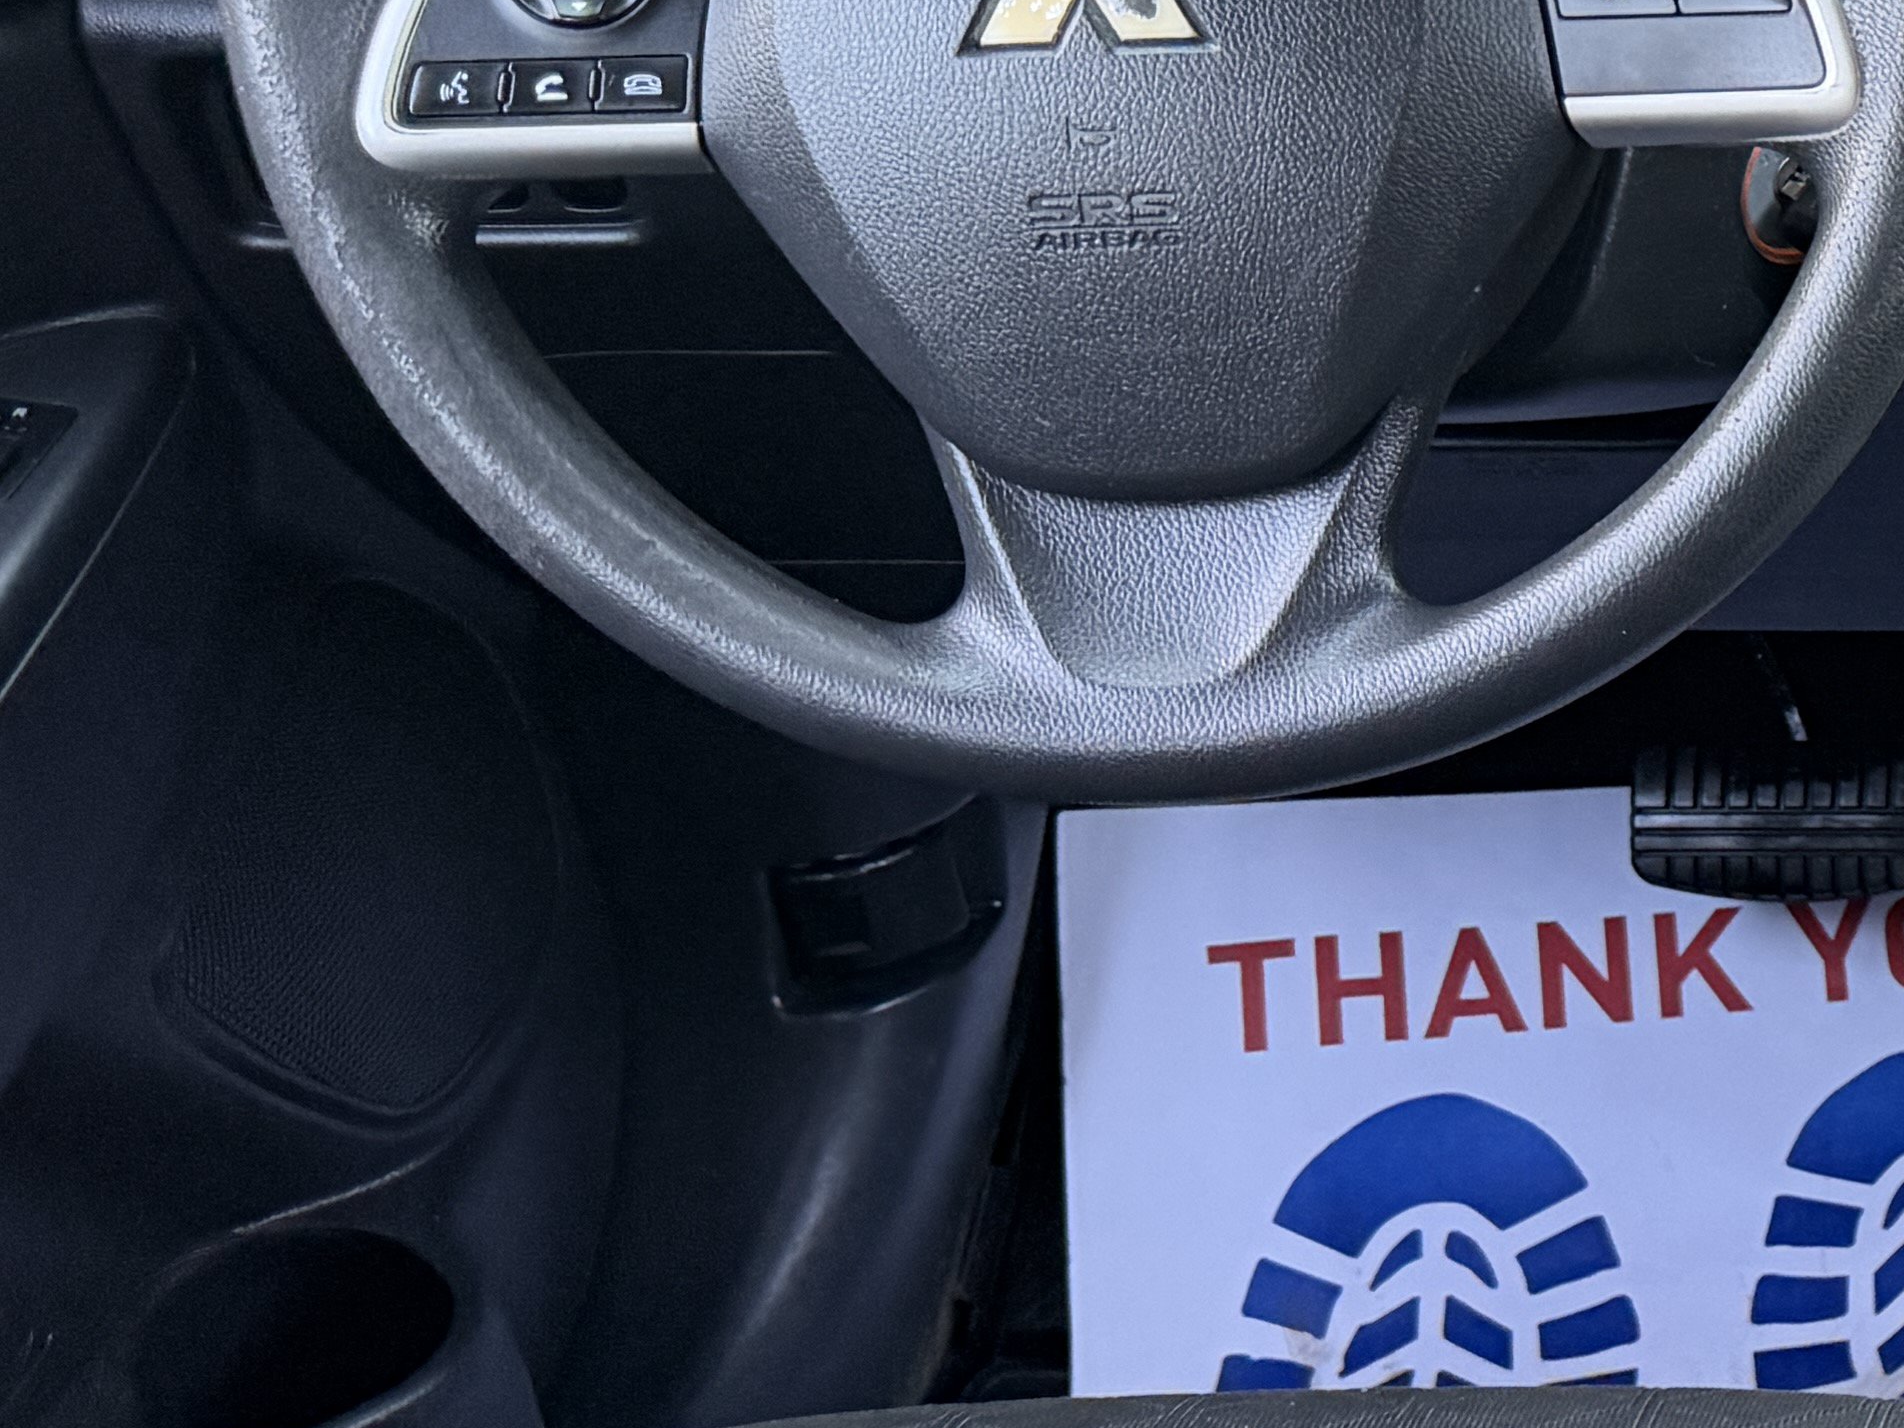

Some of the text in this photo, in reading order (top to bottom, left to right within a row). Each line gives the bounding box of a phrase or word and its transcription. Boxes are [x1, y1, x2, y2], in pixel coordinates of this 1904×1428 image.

[1028, 192, 1179, 224] SRS
[1033, 230, 1182, 251] AIRBAG
[1207, 905, 1753, 1053] THANK
